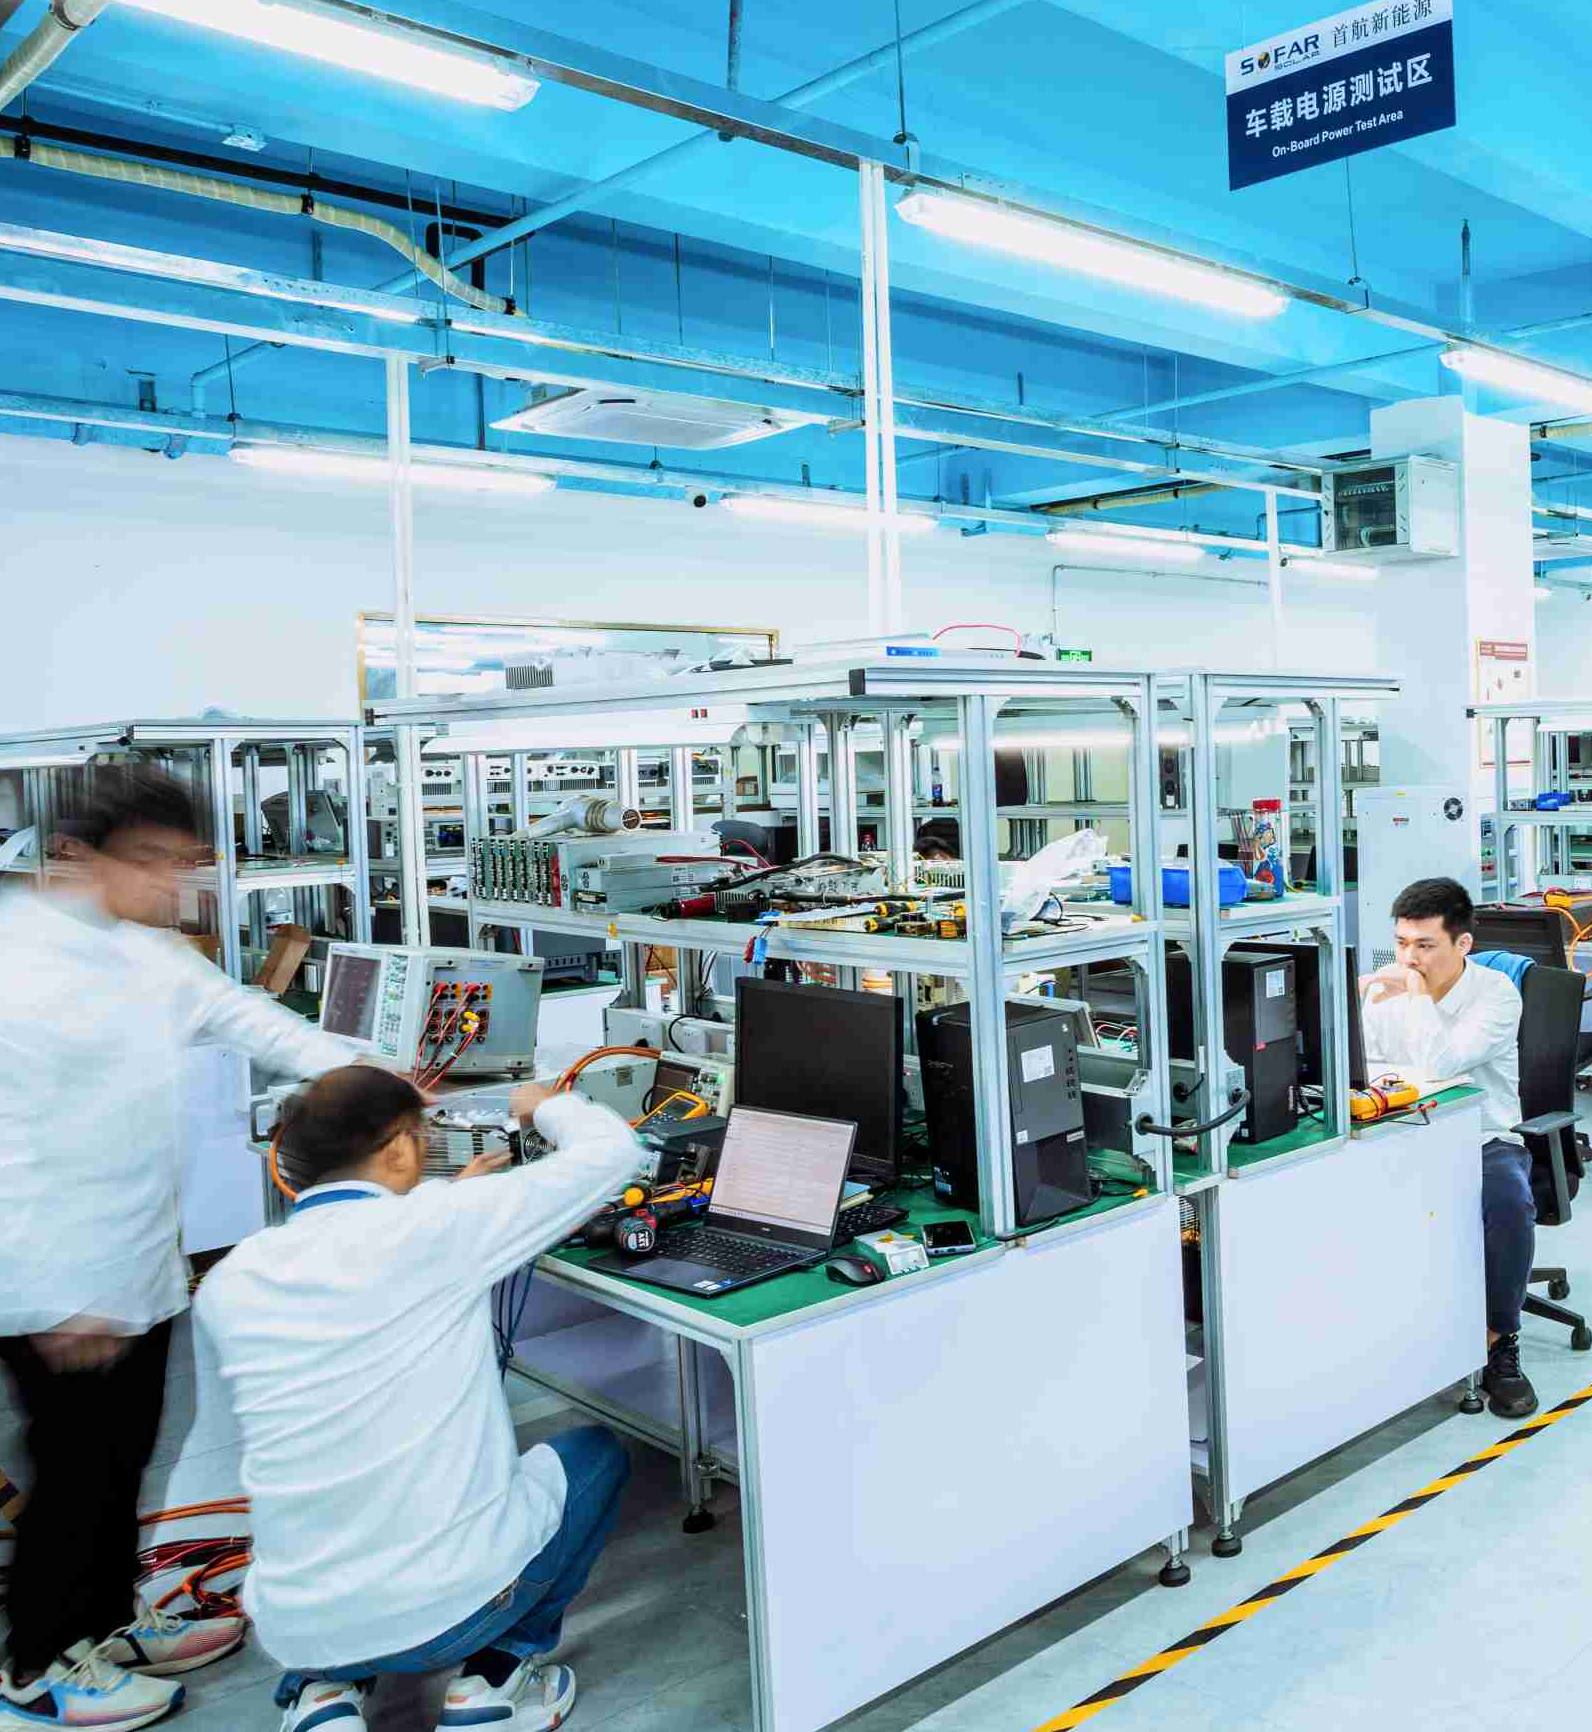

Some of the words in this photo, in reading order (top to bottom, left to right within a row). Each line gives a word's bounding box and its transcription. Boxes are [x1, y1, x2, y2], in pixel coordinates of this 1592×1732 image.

[1332, 0, 1432, 48] 首航新能源
[1245, 52, 1433, 138] 车载电源测试区
[1272, 133, 1320, 157] On-Board
[1321, 124, 1354, 142] Power
[1355, 116, 1377, 132] Test
[1378, 110, 1404, 126] Area
